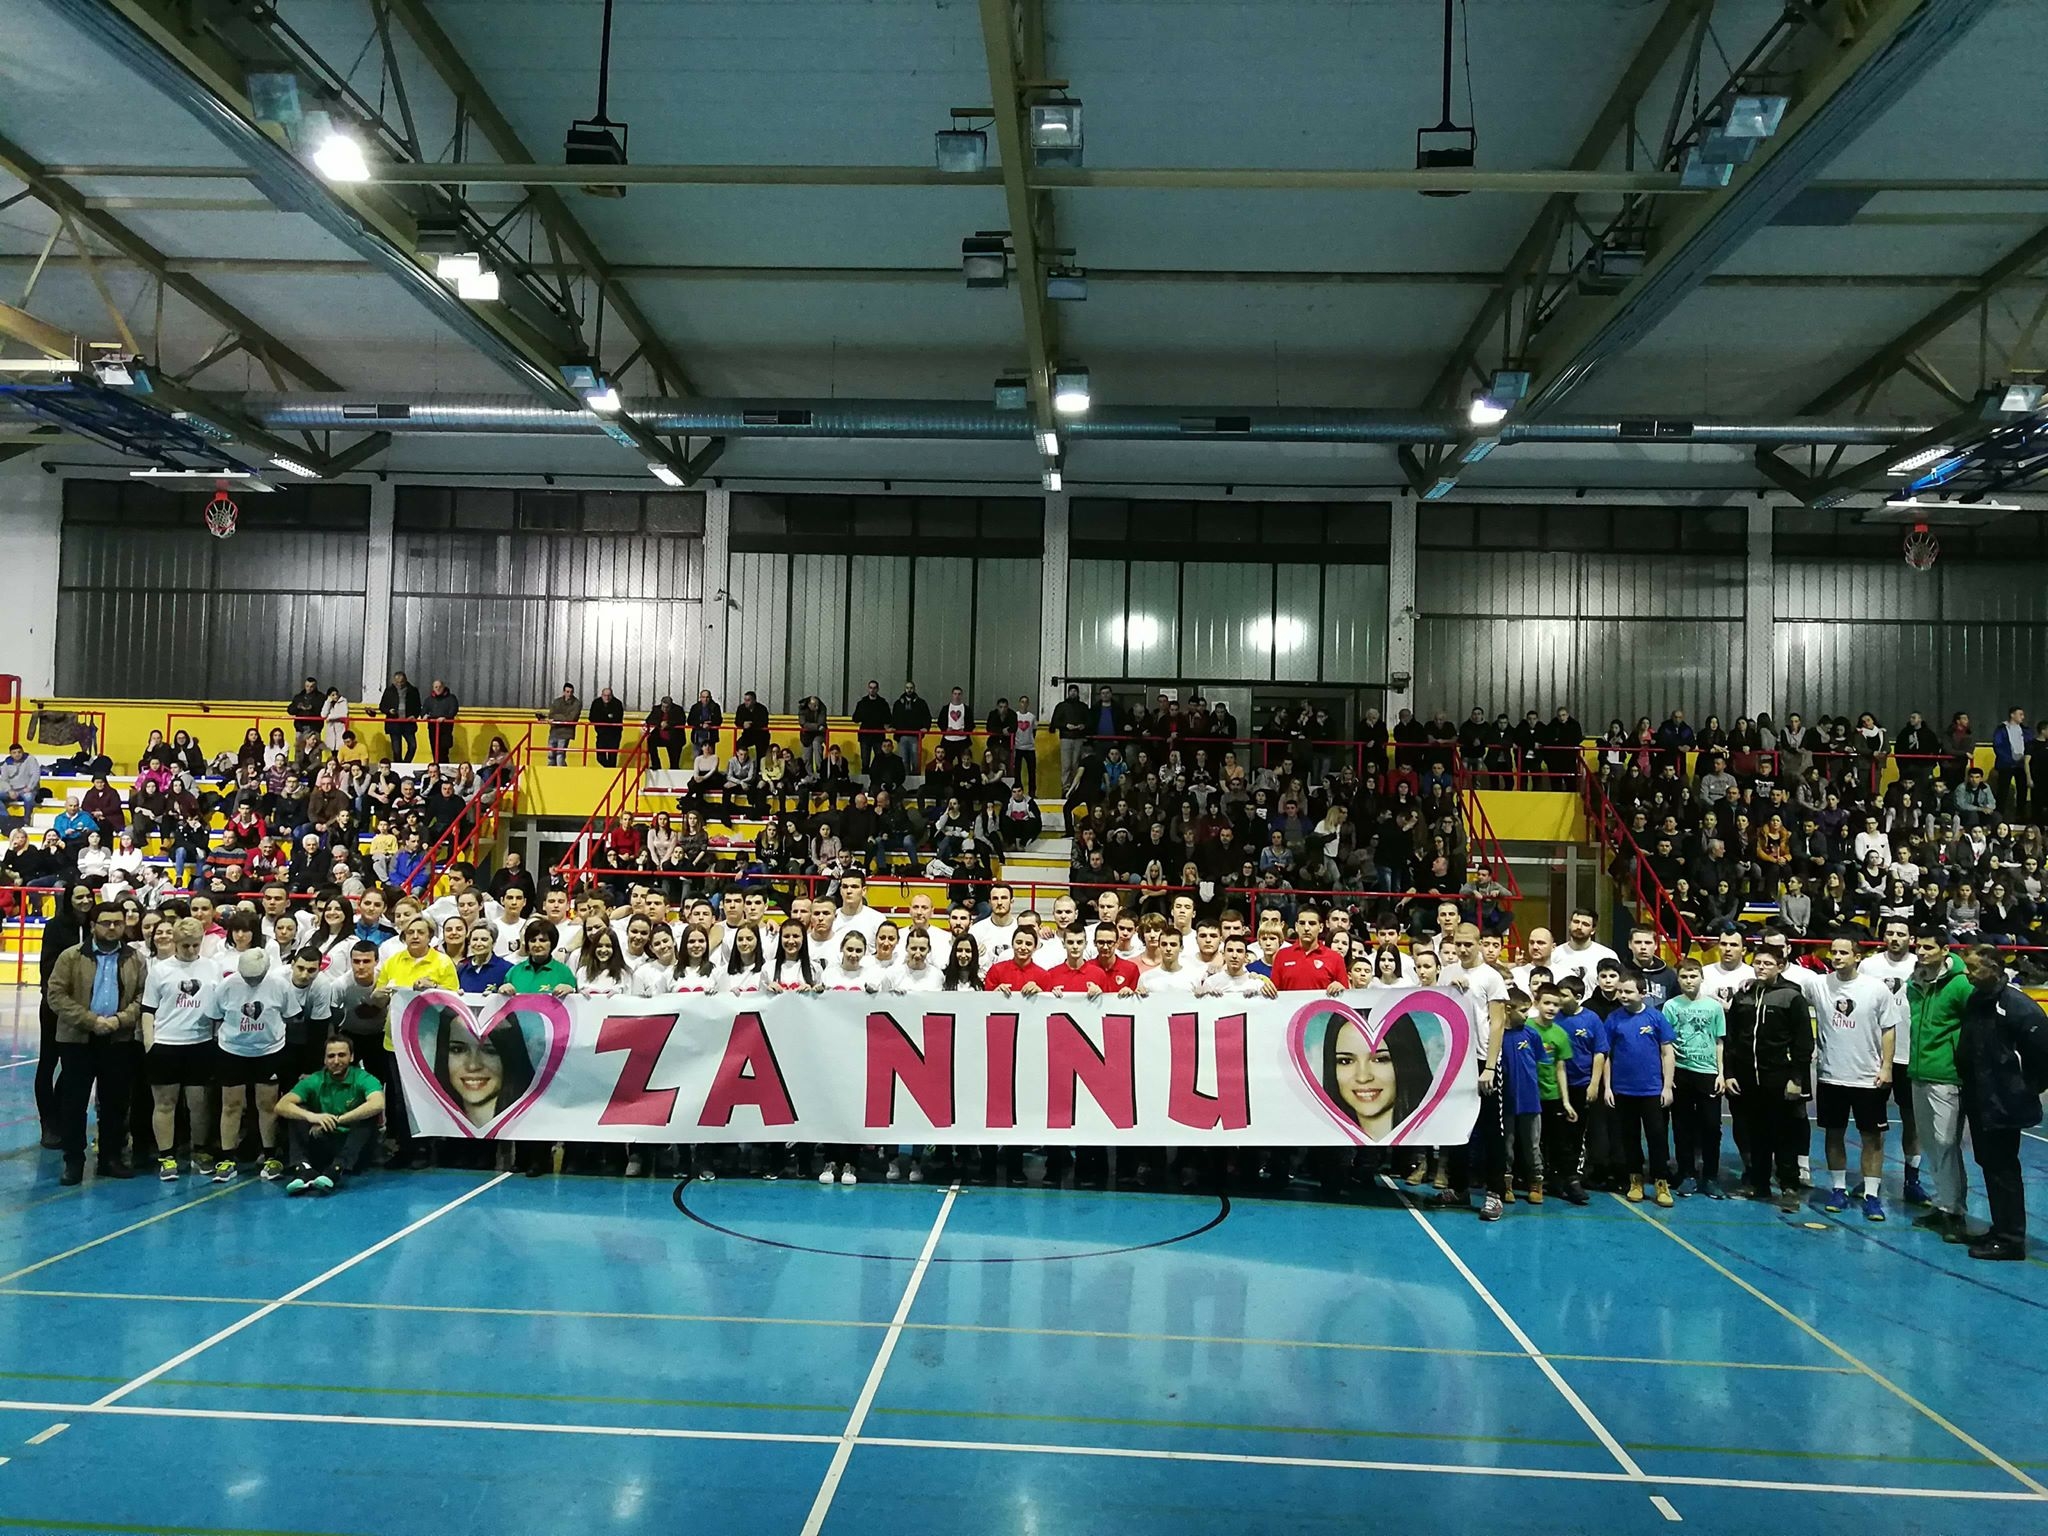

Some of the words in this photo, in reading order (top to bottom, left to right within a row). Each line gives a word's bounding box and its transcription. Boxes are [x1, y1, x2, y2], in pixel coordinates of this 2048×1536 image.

[176, 1000, 200, 1008] NINU
[240, 1023, 264, 1031] NINU
[1832, 1019, 1856, 1029] NINU
[595, 1012, 798, 1127] ZA
[864, 1012, 1251, 1130] NINU
